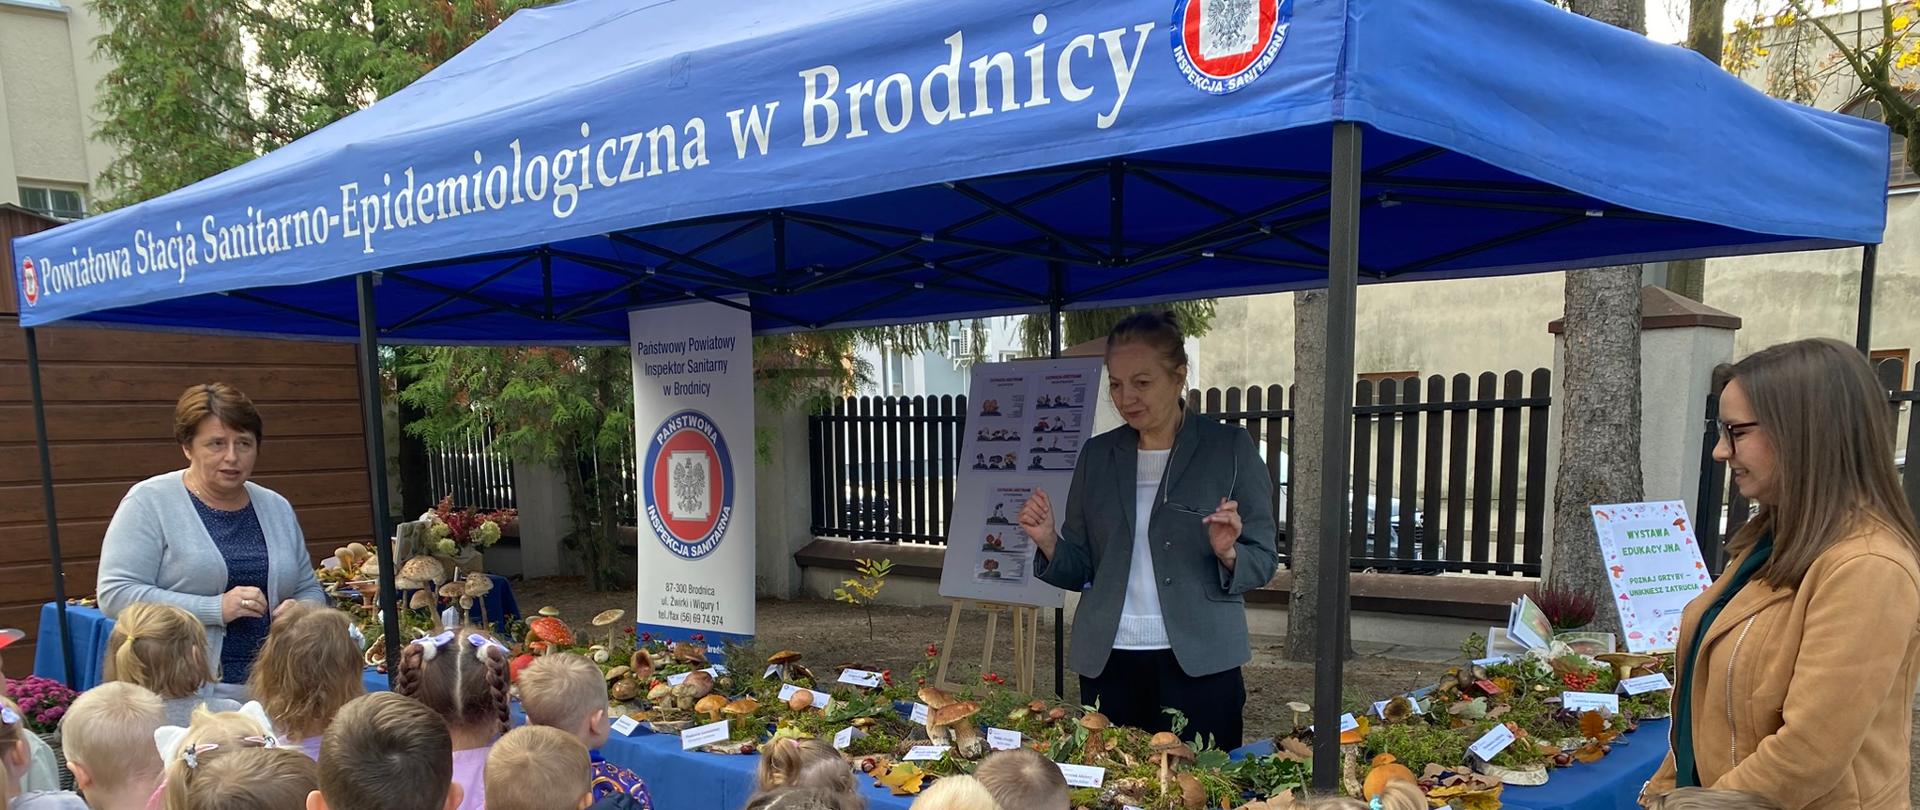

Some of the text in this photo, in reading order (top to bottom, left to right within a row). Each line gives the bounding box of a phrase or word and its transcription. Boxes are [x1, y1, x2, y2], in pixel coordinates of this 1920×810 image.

[1173, 22, 1291, 92] INSPEKCJA SANITARNA
[39, 13, 1156, 296] Powiatowa Stacja Sanitarno-Epidemiologiczna w Brodnicy
[638, 336, 735, 355] Państwowy Powiatowy
[644, 358, 728, 378] Inspektor Sanitarny
[663, 381, 711, 397] w Brodnicy
[656, 415, 718, 446] PAŃSTWOWA
[647, 505, 731, 557] INSPEKCJA SANITARNA
[1627, 528, 1670, 539] WYSTAWA
[1623, 544, 1680, 556] EDUKACYJNA
[1629, 575, 1657, 585] POZNAJ
[1660, 574, 1684, 582] GRZYBY
[665, 582, 715, 596] 87-300 Brodnica
[1666, 583, 1699, 592] ZATRUCIA
[693, 600, 715, 612] Wigury
[680, 612, 692, 624] (56)
[692, 613, 701, 624] 69
[702, 614, 711, 624] 74
[711, 615, 724, 626] 974
